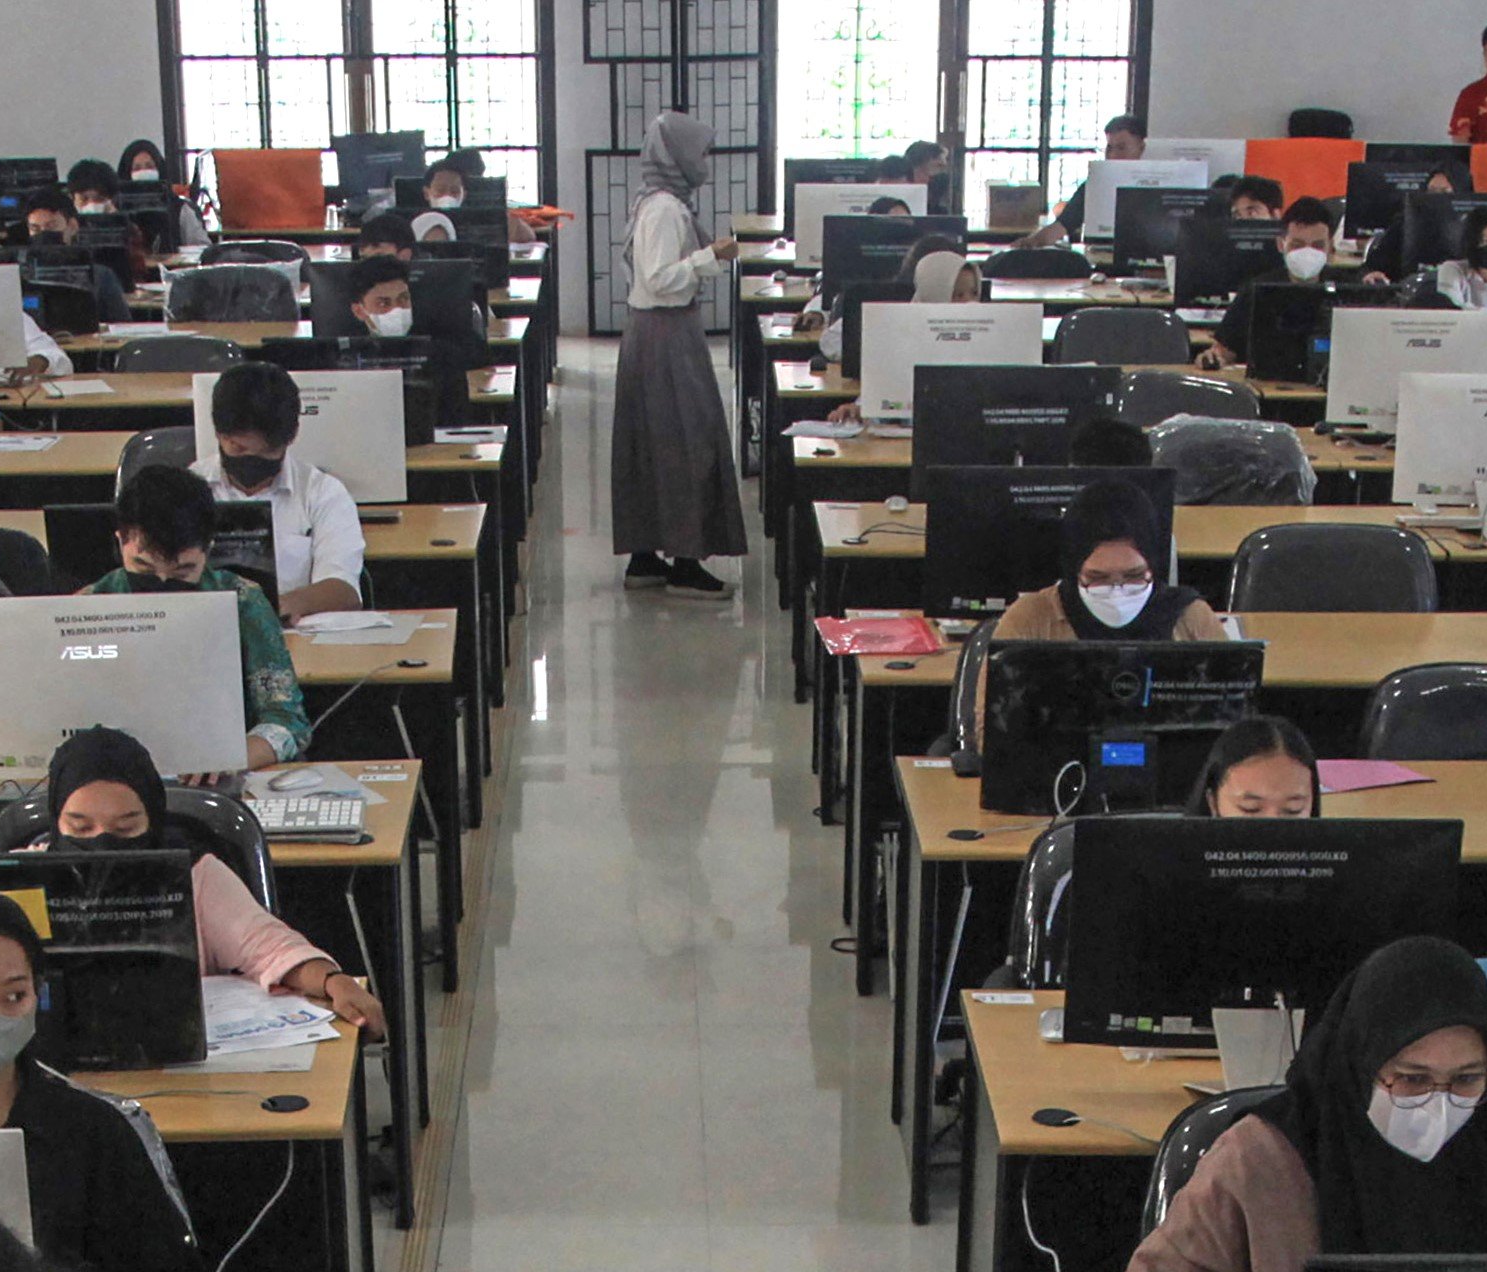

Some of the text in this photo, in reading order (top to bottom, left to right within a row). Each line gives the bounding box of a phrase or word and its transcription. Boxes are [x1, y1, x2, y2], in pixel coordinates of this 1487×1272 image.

[936, 332, 972, 342] ASUS
[1406, 338, 1443, 348] ASUS
[59, 645, 119, 660] ASUS
